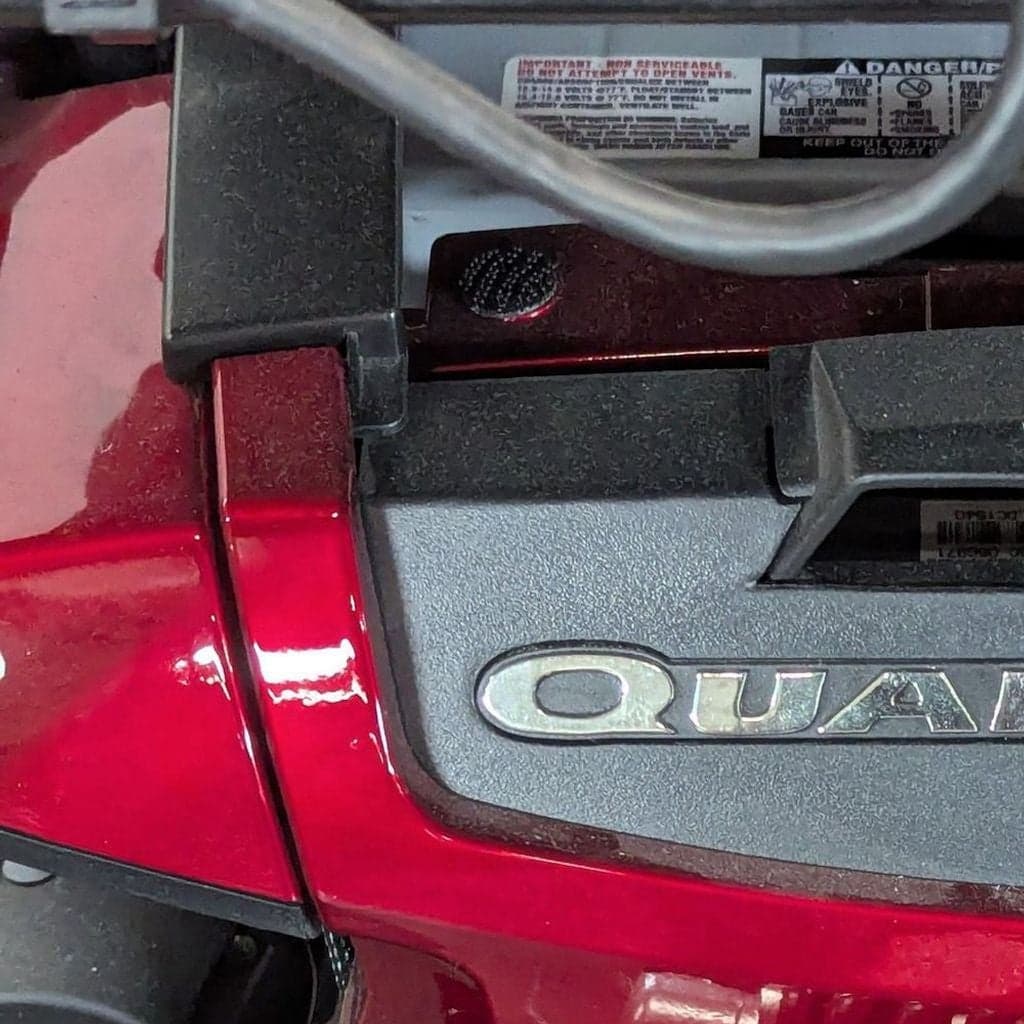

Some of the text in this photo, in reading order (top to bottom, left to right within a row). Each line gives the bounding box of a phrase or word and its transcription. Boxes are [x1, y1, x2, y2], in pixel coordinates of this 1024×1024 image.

[519, 60, 590, 69] IMPORTANT
[568, 69, 628, 78] ATTEMPT
[632, 70, 650, 78] TO
[654, 70, 687, 78] OPEN
[803, 138, 848, 148] KEEP
[851, 138, 884, 148] OUT
